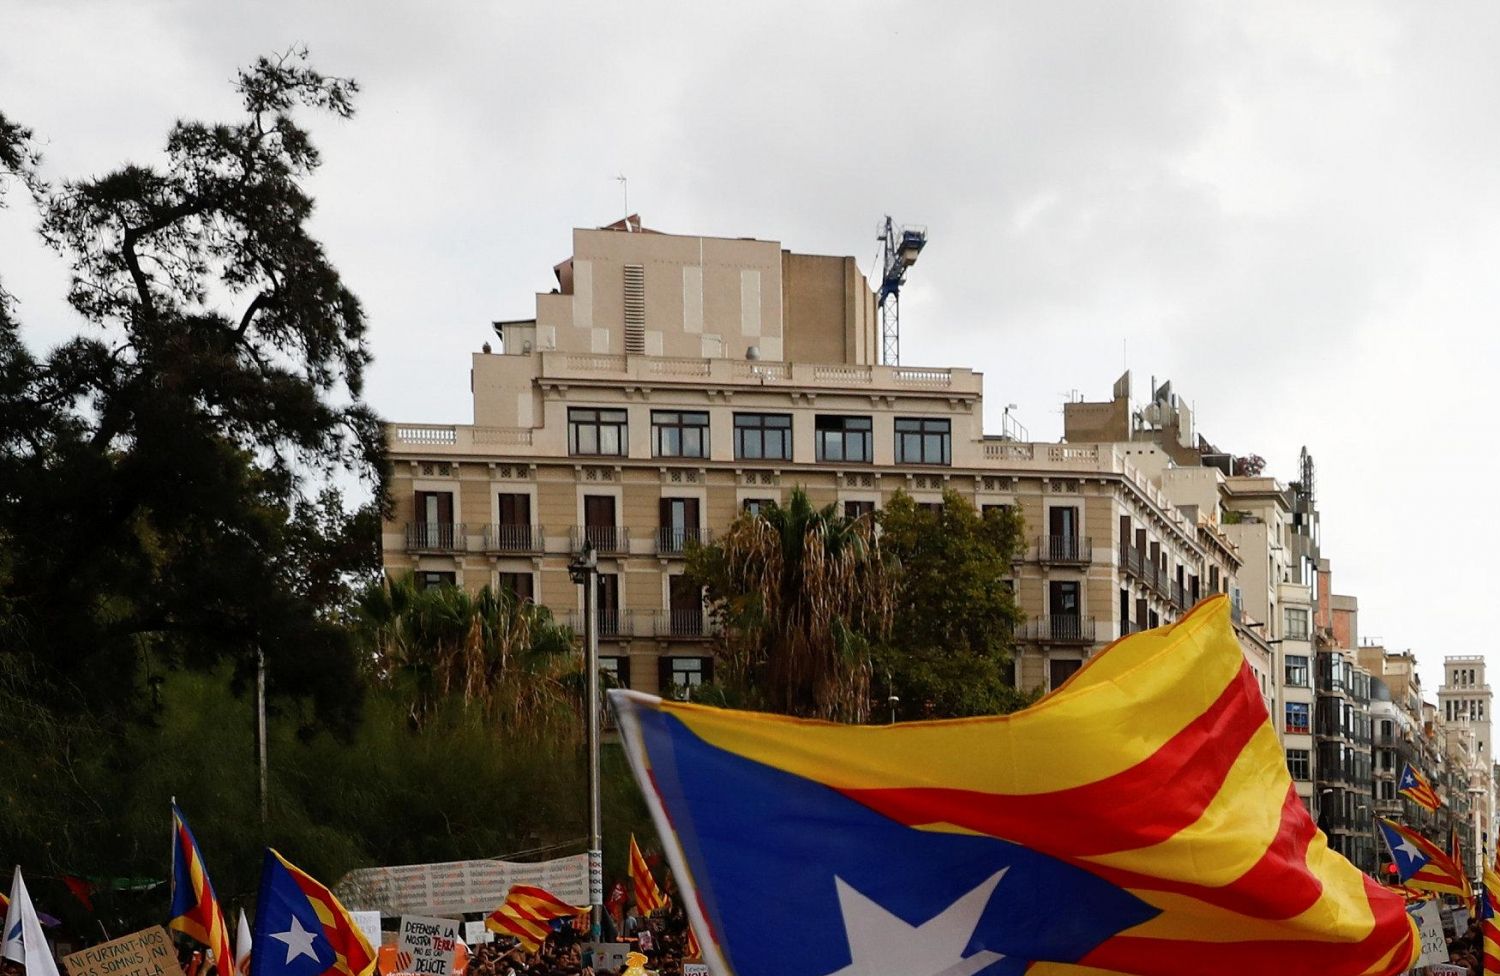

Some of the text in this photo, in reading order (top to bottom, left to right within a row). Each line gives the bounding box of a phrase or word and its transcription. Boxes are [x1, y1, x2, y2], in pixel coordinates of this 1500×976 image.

[405, 921, 455, 938] DEFENSAR LA
[1429, 928, 1437, 938] LA
[405, 935, 455, 950] NOSTRA TERRA
[69, 931, 164, 968] NI FURTANT-NOS
[151, 946, 168, 959] NI
[414, 947, 424, 955] NO
[145, 964, 164, 976] LA
